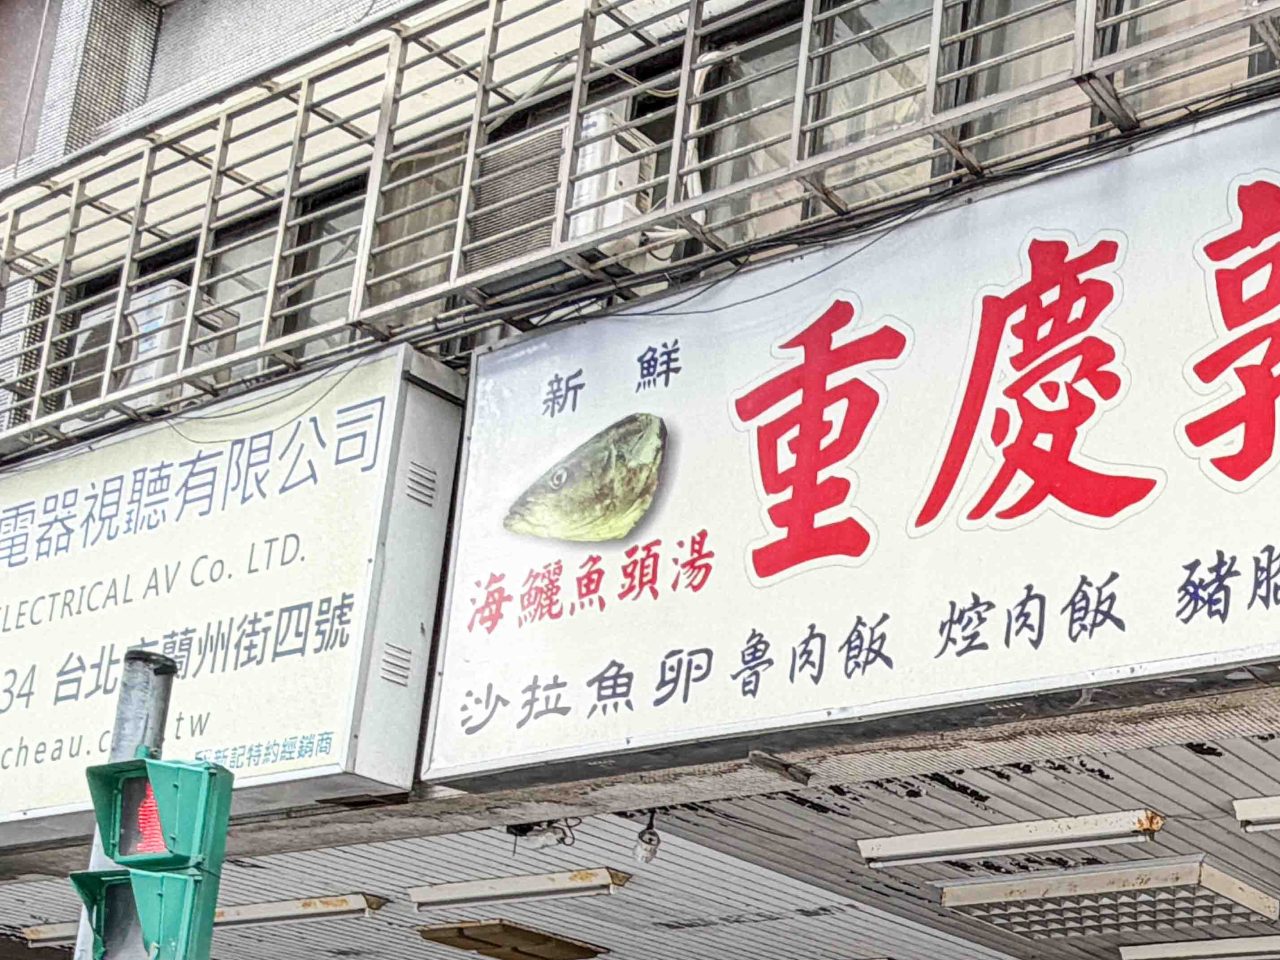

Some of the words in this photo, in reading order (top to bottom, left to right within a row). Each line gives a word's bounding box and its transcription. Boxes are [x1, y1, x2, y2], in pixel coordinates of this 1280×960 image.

[542, 340, 683, 417] 新鮮
[0, 396, 386, 568] 電器視聽有限公司
[0, 574, 133, 633] LECTRICAL
[143, 561, 181, 599] AV
[190, 554, 233, 587] Co.
[247, 532, 305, 575] LTD.
[53, 592, 355, 705] 台北蘭州街四號
[460, 648, 713, 736] 沙拉魚卵
[730, 614, 893, 697] 魯肉飯
